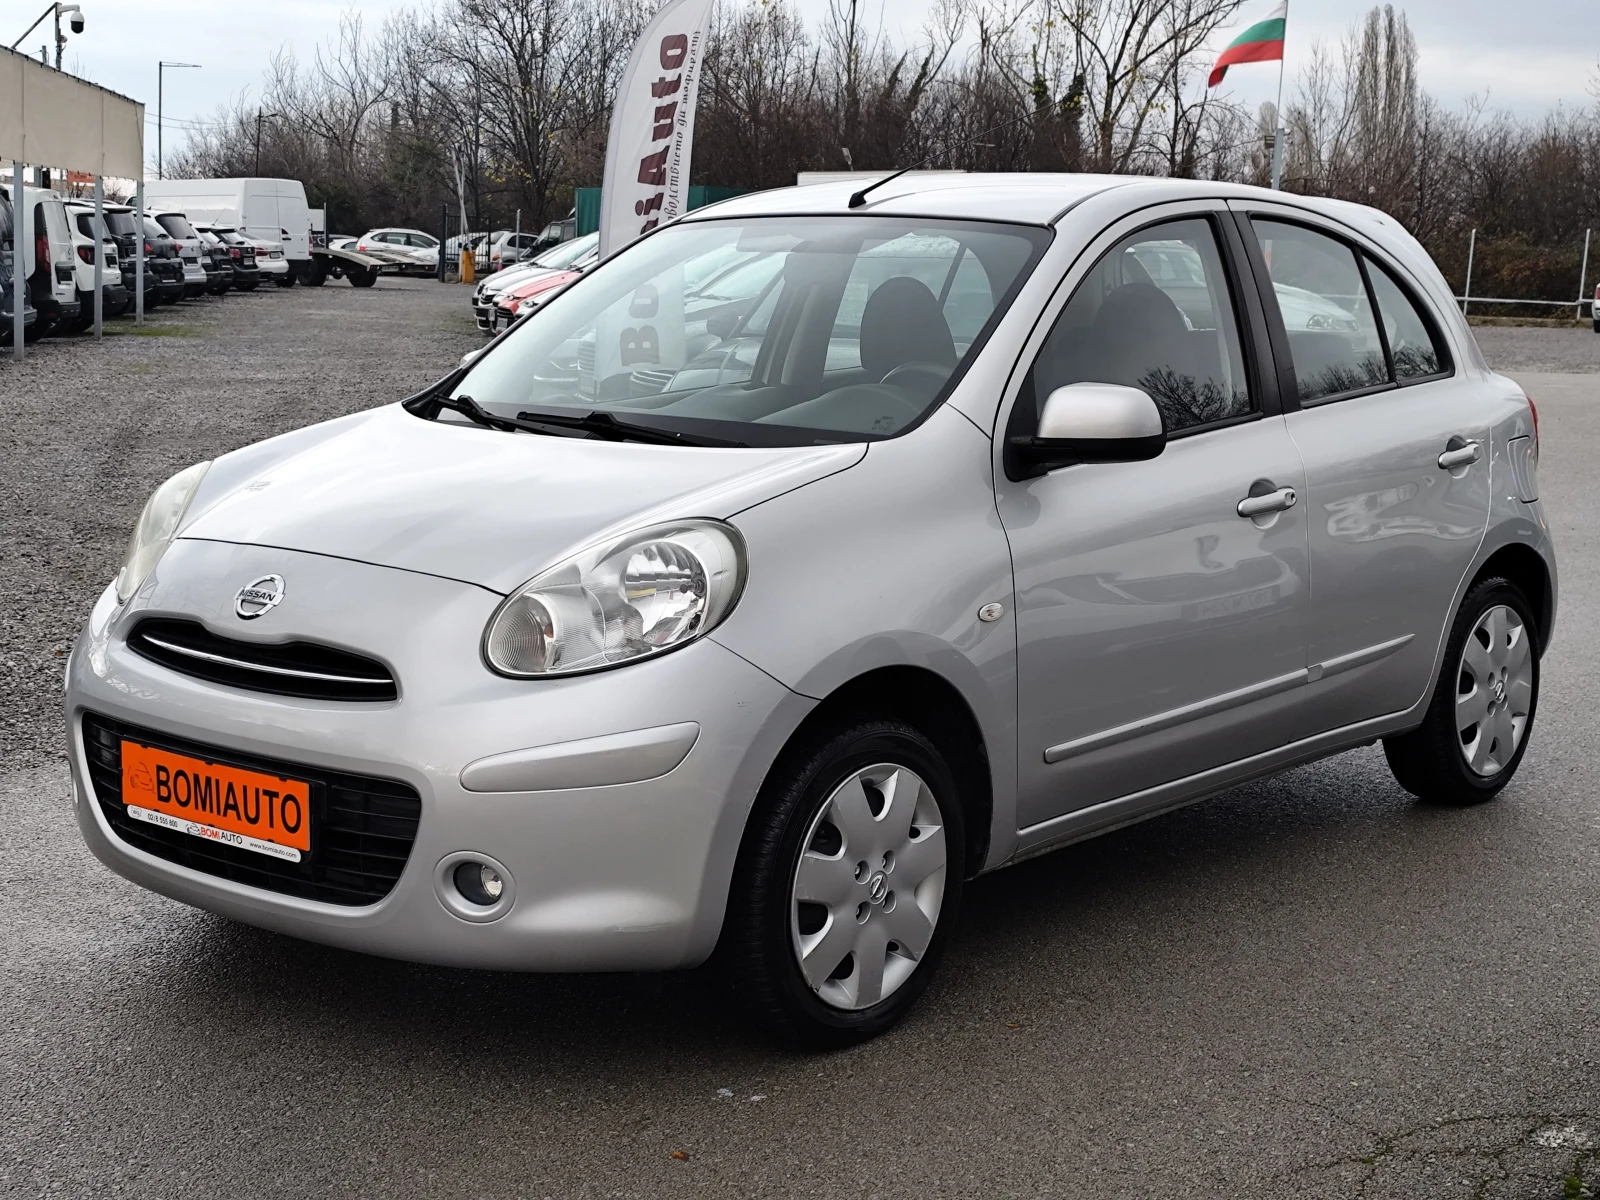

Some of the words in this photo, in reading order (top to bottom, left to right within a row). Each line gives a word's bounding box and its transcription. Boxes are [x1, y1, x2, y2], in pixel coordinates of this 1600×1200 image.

[240, 590, 276, 601] NISSAN
[156, 764, 302, 834] BOMIAUTO
[249, 842, 298, 859] www.bomiauto.com
